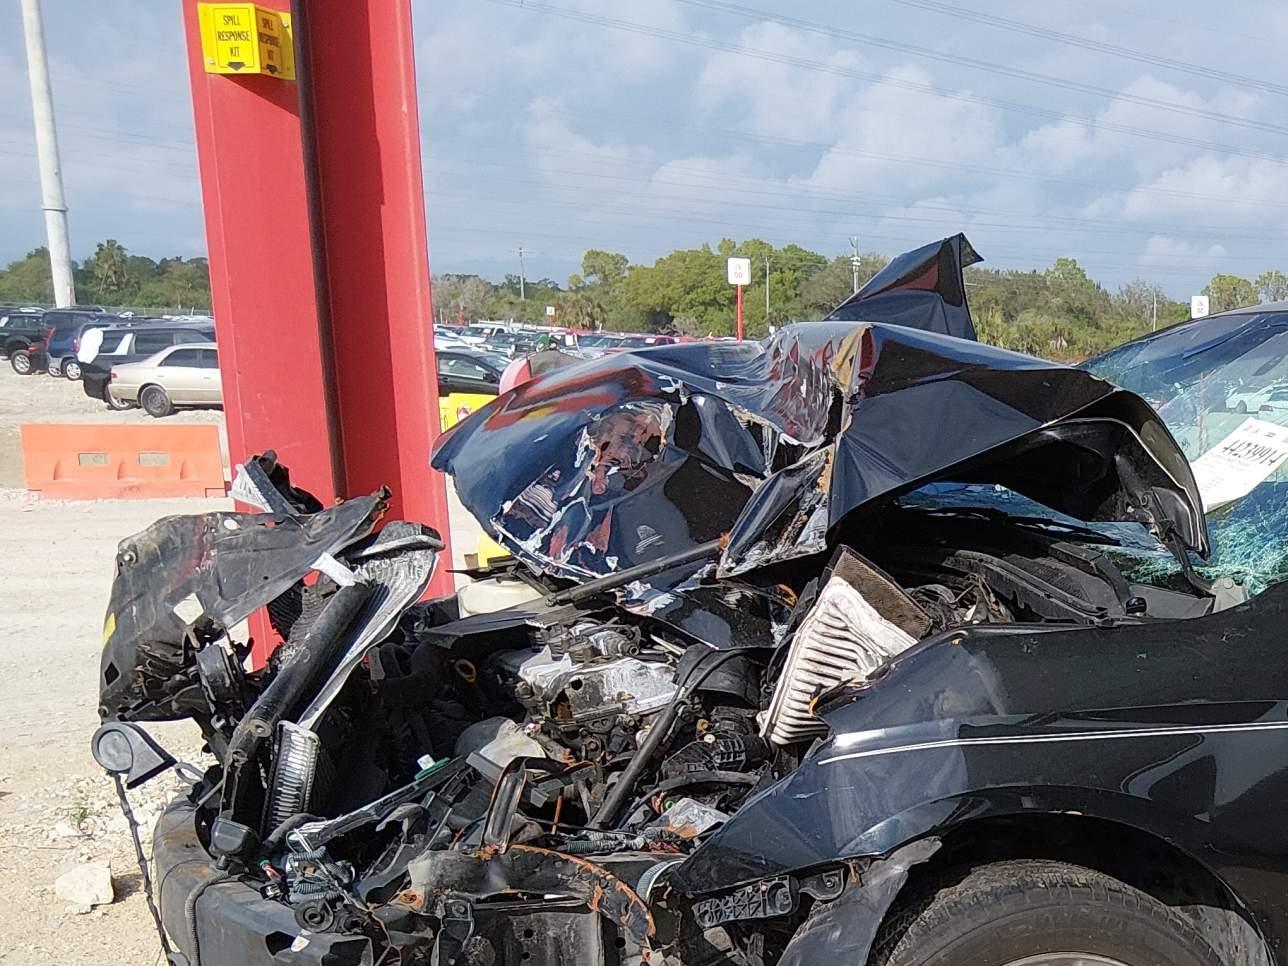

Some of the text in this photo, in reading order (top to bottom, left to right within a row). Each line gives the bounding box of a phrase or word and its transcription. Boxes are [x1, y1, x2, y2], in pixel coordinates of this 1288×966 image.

[223, 15, 241, 26] SPILL
[217, 30, 250, 41] RESPONSE
[229, 46, 240, 57] KIT
